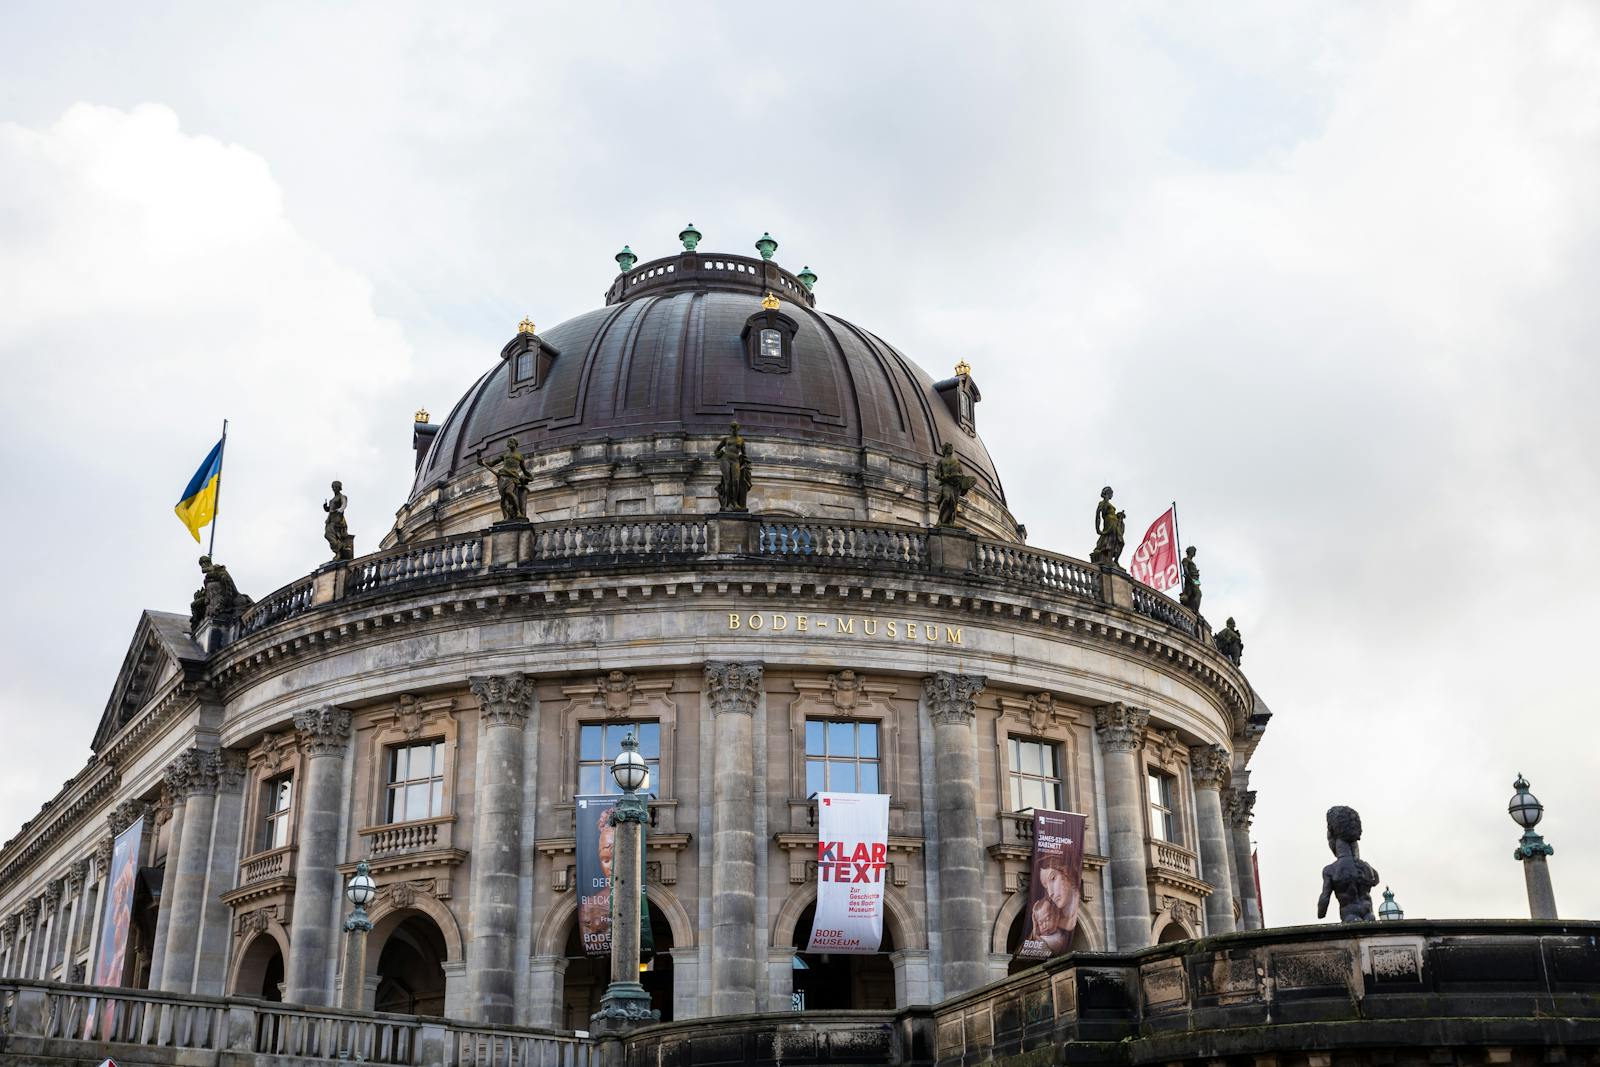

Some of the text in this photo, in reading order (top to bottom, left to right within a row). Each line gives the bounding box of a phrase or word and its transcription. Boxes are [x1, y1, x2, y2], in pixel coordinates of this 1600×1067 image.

[728, 613, 963, 644] BODE-MUSEUM
[818, 841, 887, 863] KLAR
[818, 862, 886, 883] TEXT
[592, 877, 611, 888] DER
[581, 895, 610, 905] BLICK
[583, 933, 612, 943] BODE
[815, 929, 844, 938] BODE
[812, 938, 860, 947] MUSEUM
[1023, 939, 1044, 950] BODE
[1018, 947, 1053, 958] MUSEUM
